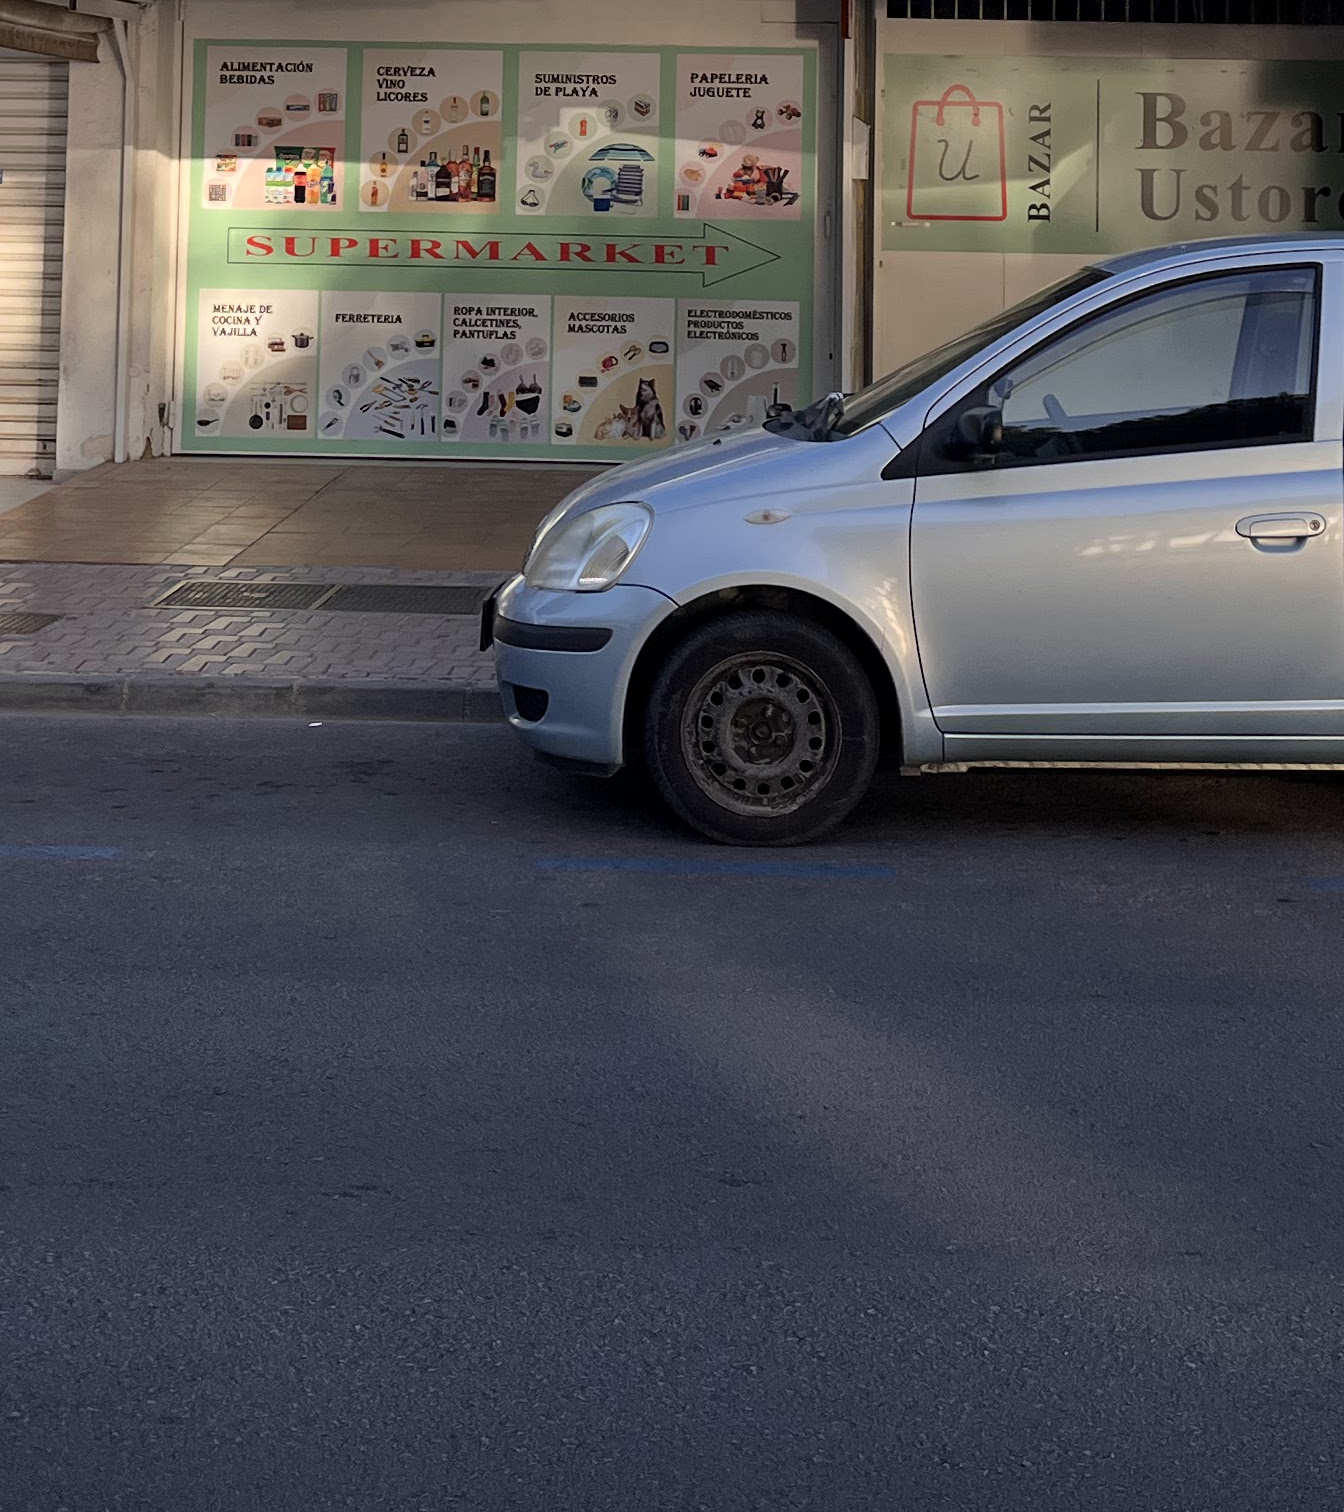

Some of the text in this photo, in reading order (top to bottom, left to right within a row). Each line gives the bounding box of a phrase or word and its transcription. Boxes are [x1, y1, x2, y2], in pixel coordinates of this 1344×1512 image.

[220, 60, 313, 73] ALIMENTACIÓN
[376, 66, 436, 77] CERVEZA
[220, 74, 275, 85] BEBIDAS
[376, 79, 405, 89] VINO
[535, 74, 616, 85] SUMINISTROS
[690, 73, 769, 85] PAPELERIA
[376, 91, 428, 102] LICORES
[535, 86, 552, 96] DE
[690, 87, 751, 98] JUGUETE
[1027, 101, 1052, 223] BAZAR
[245, 235, 729, 267] SUPERMARKET
[212, 304, 273, 314] MENAJE DE
[454, 307, 538, 318] ROPA INTERIOR,
[687, 309, 792, 320] ELECTRODOMÉSTICOS
[212, 316, 263, 325] COCINA Y
[335, 314, 403, 324] FERRETERIA
[568, 312, 635, 322] ACCESORIOS
[453, 318, 522, 329] CALCETINES,
[567, 324, 627, 334] MASCOTAS
[687, 320, 744, 329] PRODUCTOS
[212, 327, 257, 337] VAJILLA
[454, 330, 516, 340] PANTUFLAS
[687, 330, 759, 340] ELECTRÓNICOS
